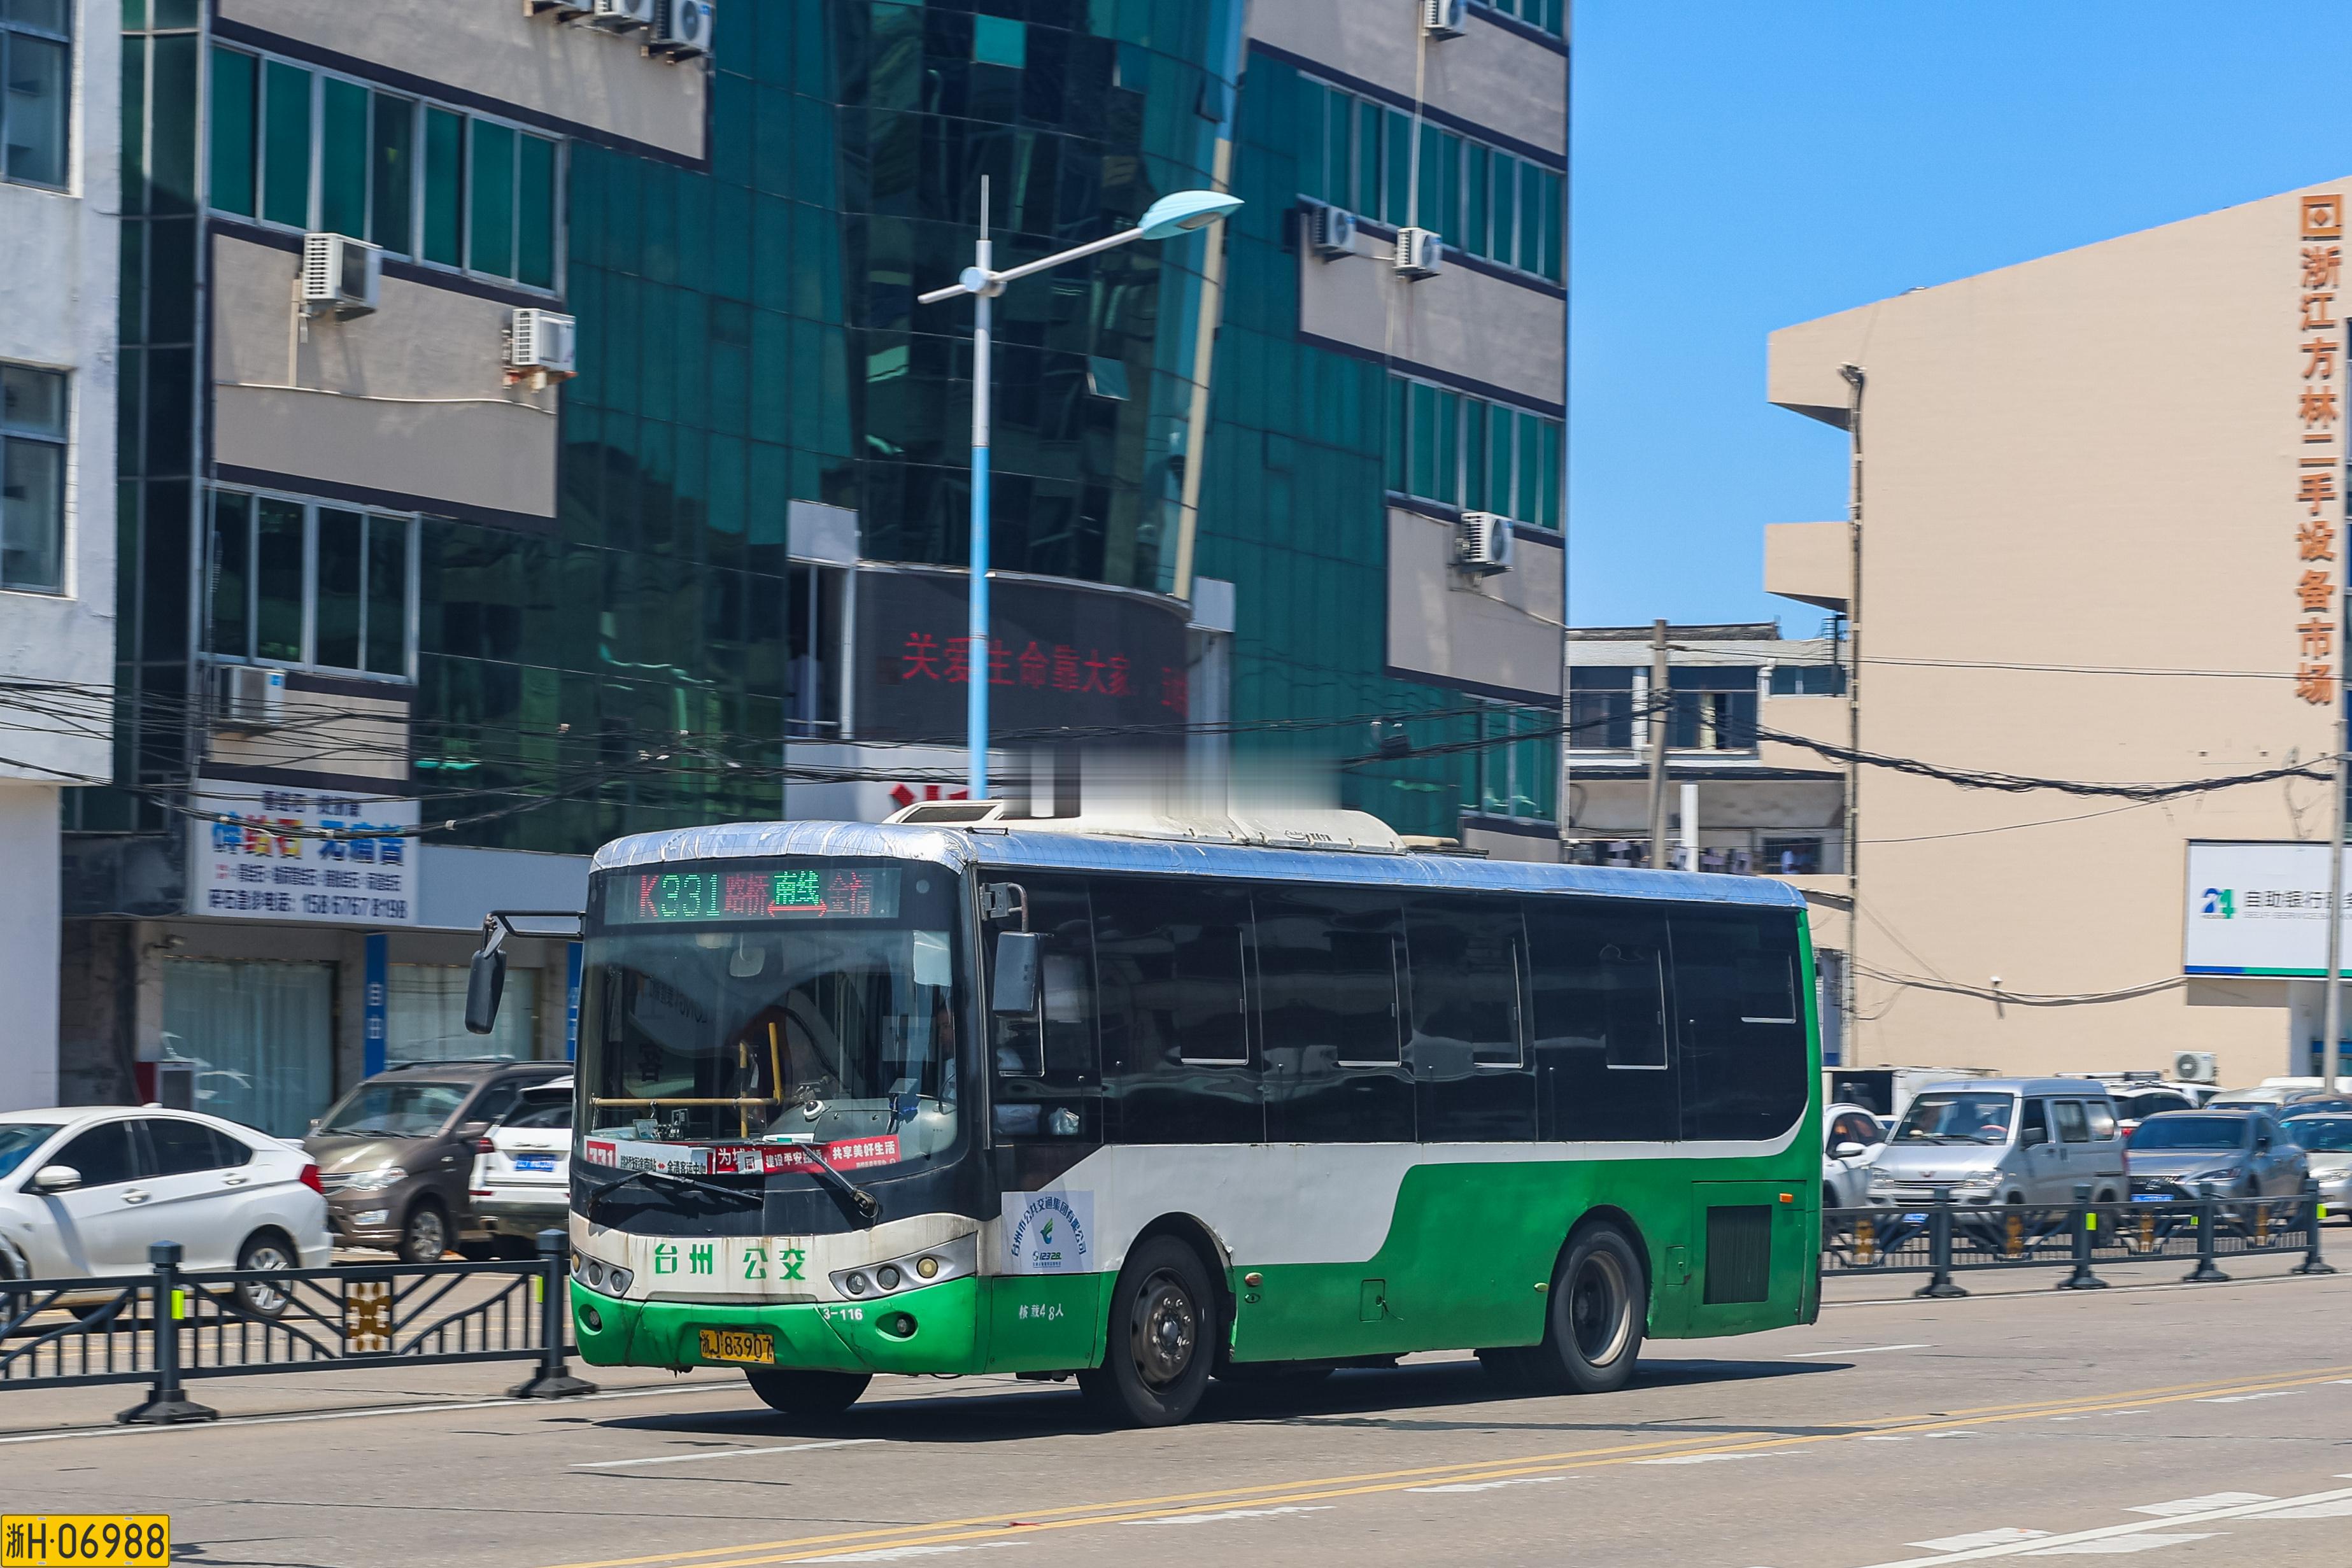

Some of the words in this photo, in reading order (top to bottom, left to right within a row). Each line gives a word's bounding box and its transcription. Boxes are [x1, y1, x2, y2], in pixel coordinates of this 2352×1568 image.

[2293, 246, 2341, 707] 浙江方林二手设备市场
[902, 632, 1131, 696] 关爱生命靠大家
[640, 873, 720, 917] K331
[774, 871, 820, 905] 南线
[833, 1140, 896, 1161] 共享美好生活
[1011, 1196, 1087, 1257] 台州市公共交通集团有限公司
[655, 1243, 713, 1275] 台州
[744, 1248, 806, 1280] 公交
[823, 1308, 863, 1321] 3-116
